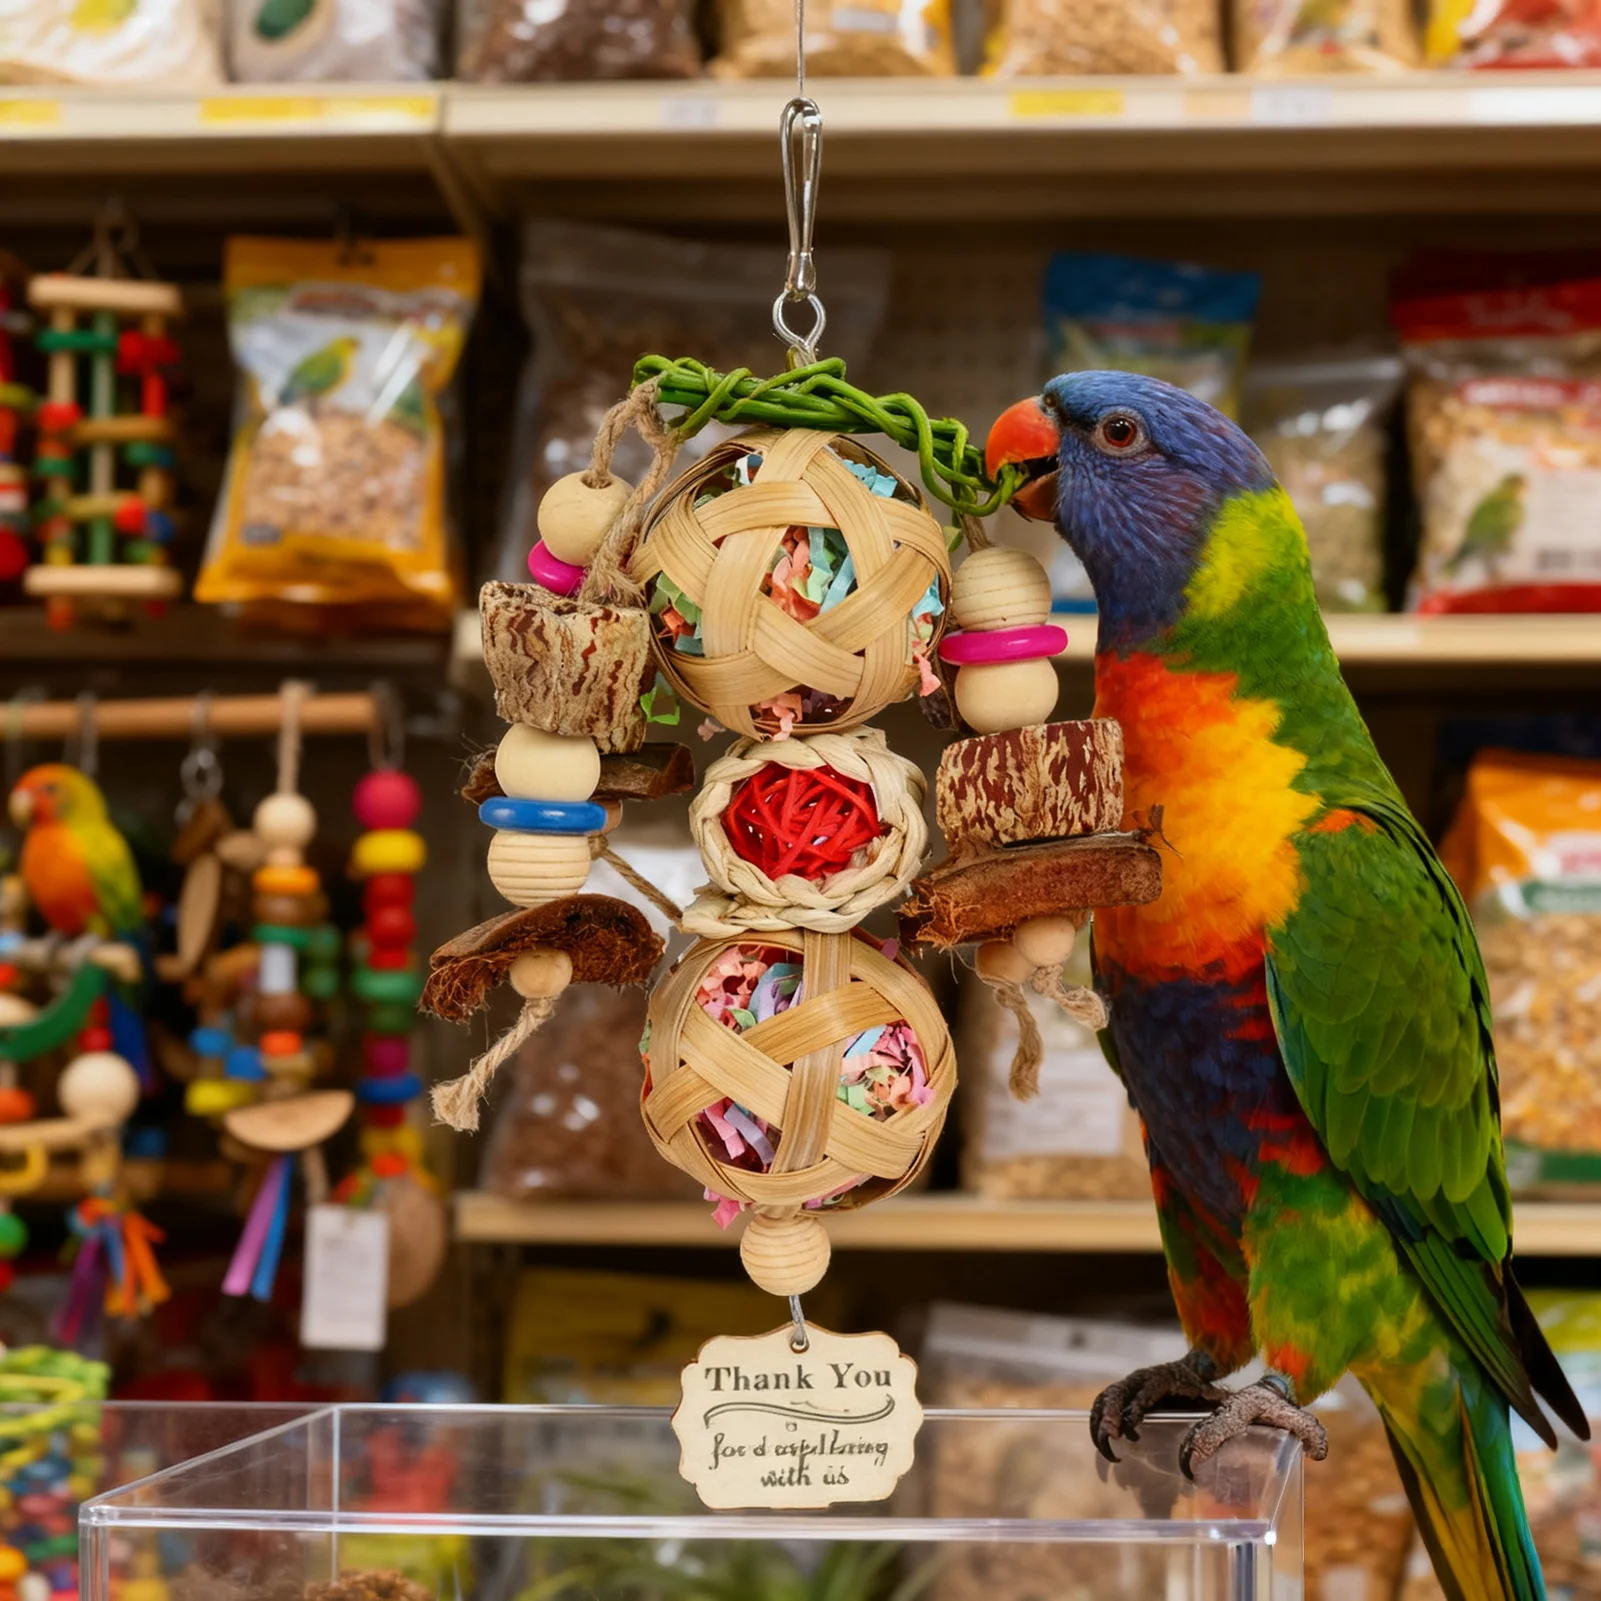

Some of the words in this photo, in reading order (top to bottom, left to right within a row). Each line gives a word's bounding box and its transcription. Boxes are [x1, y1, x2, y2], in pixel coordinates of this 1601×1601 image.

[704, 1364, 814, 1392] Thank
[827, 1362, 892, 1389] You
[760, 1466, 812, 1488] with
